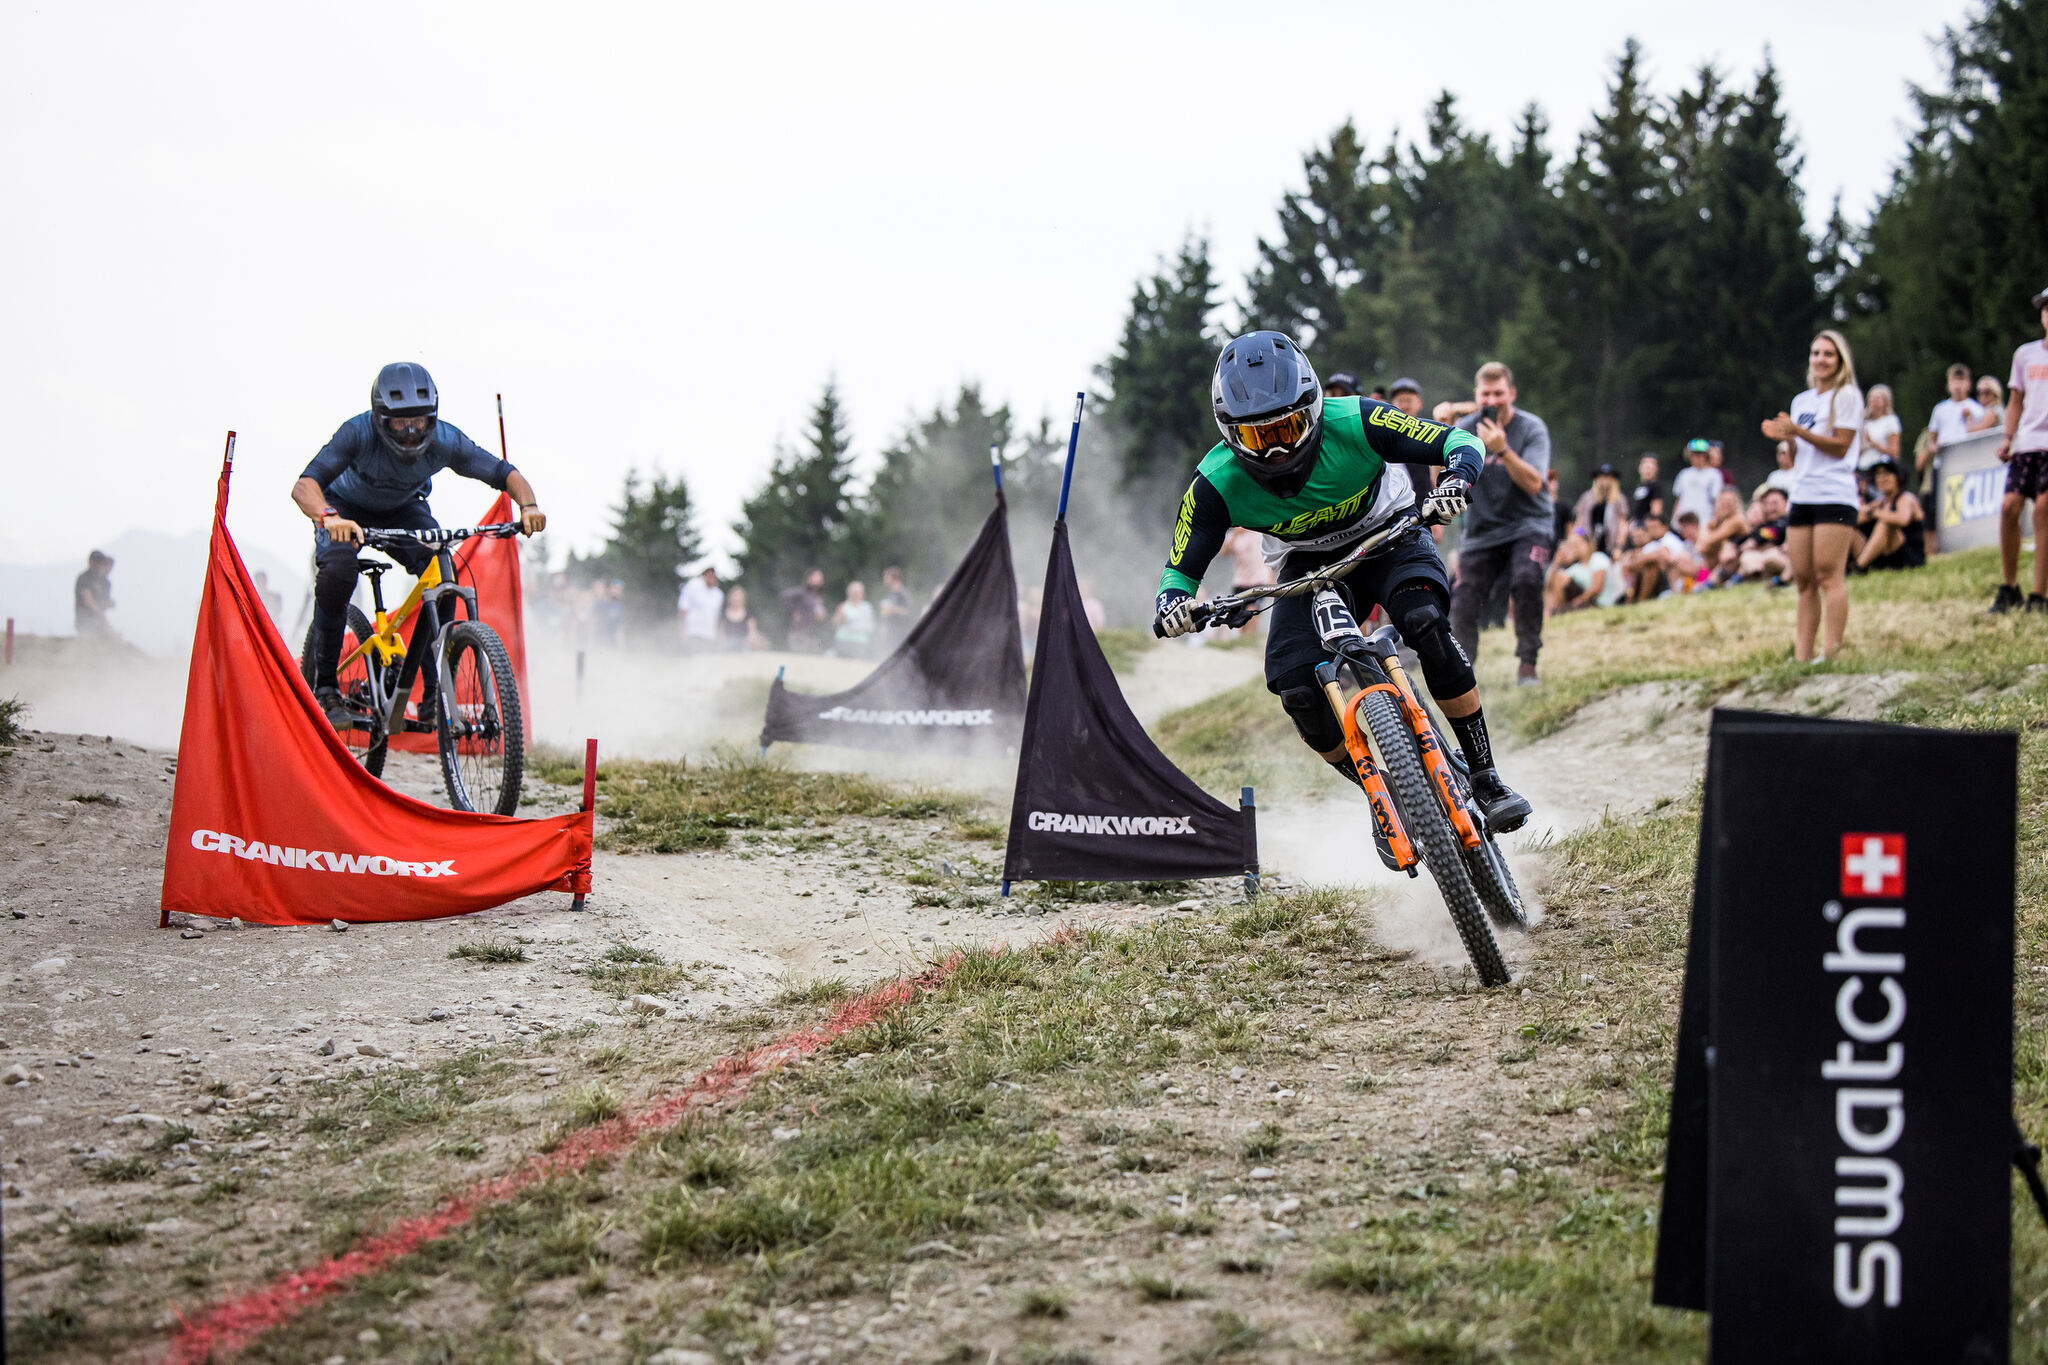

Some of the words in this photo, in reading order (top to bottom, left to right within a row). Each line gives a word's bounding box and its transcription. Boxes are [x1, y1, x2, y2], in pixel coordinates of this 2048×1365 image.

[1369, 405, 1448, 444] LEATT
[1428, 487, 1457, 498] LEATT
[1268, 486, 1369, 535] LEATT
[1162, 595, 1187, 615] LEATT
[1317, 604, 1355, 634] 15
[1028, 811, 1196, 835] CRANKWORX
[191, 829, 458, 878] CRANKWORX
[1822, 907, 1906, 1308] swatch
